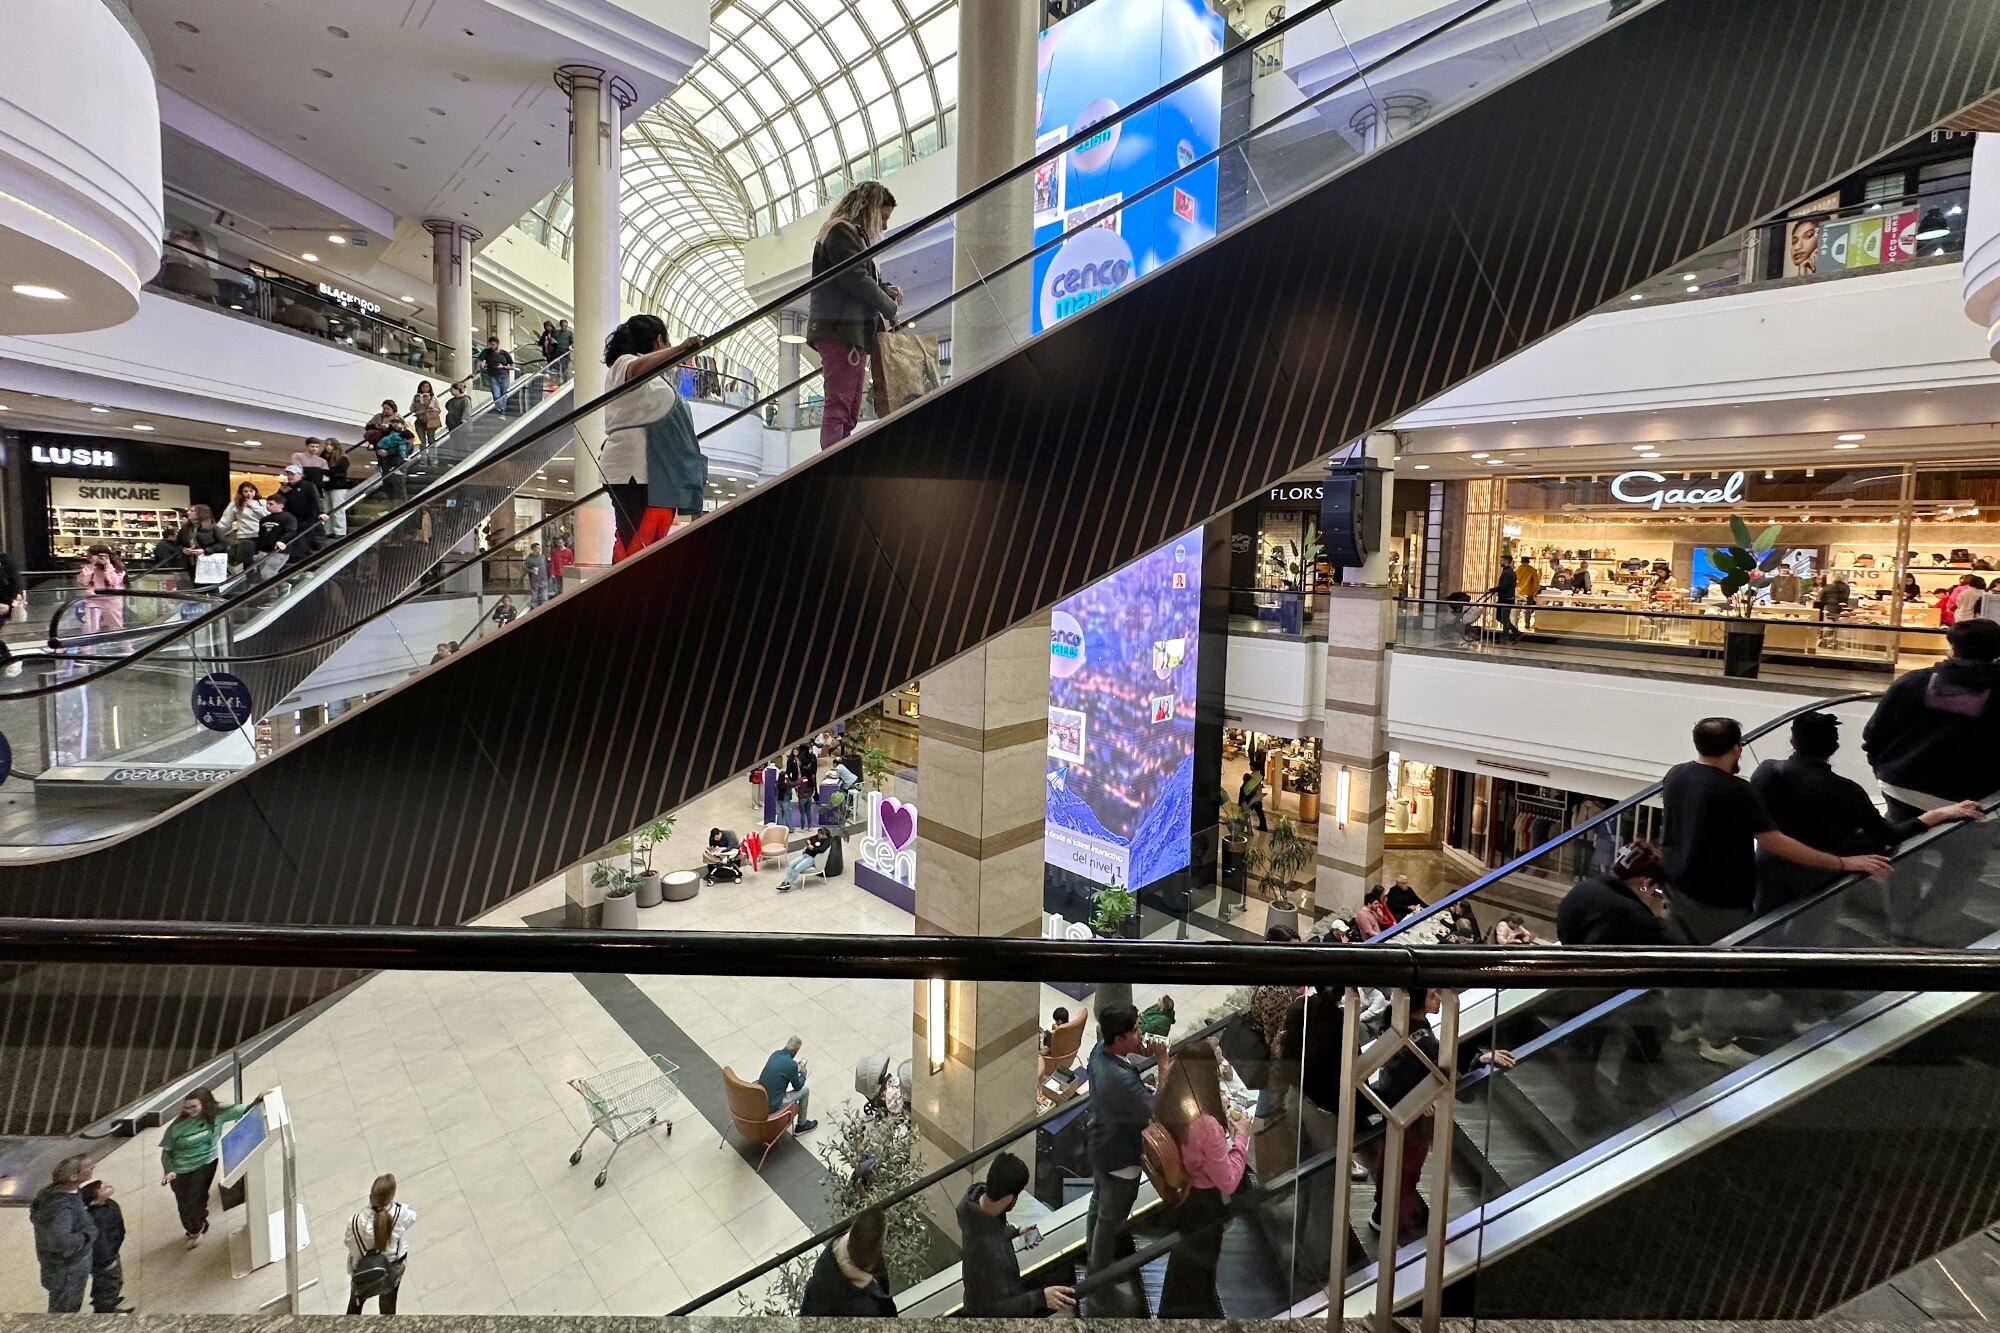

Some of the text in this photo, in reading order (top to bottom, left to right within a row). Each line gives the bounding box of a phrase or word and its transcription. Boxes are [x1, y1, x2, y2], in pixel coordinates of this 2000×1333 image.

[1051, 259, 1128, 297] cenco
[319, 282, 381, 314] BLACKDROP
[32, 445, 114, 467] LUSH
[78, 485, 160, 500] SKINCARE
[1610, 470, 1745, 511] Gacel
[1072, 851, 1122, 878] del nivel 1
